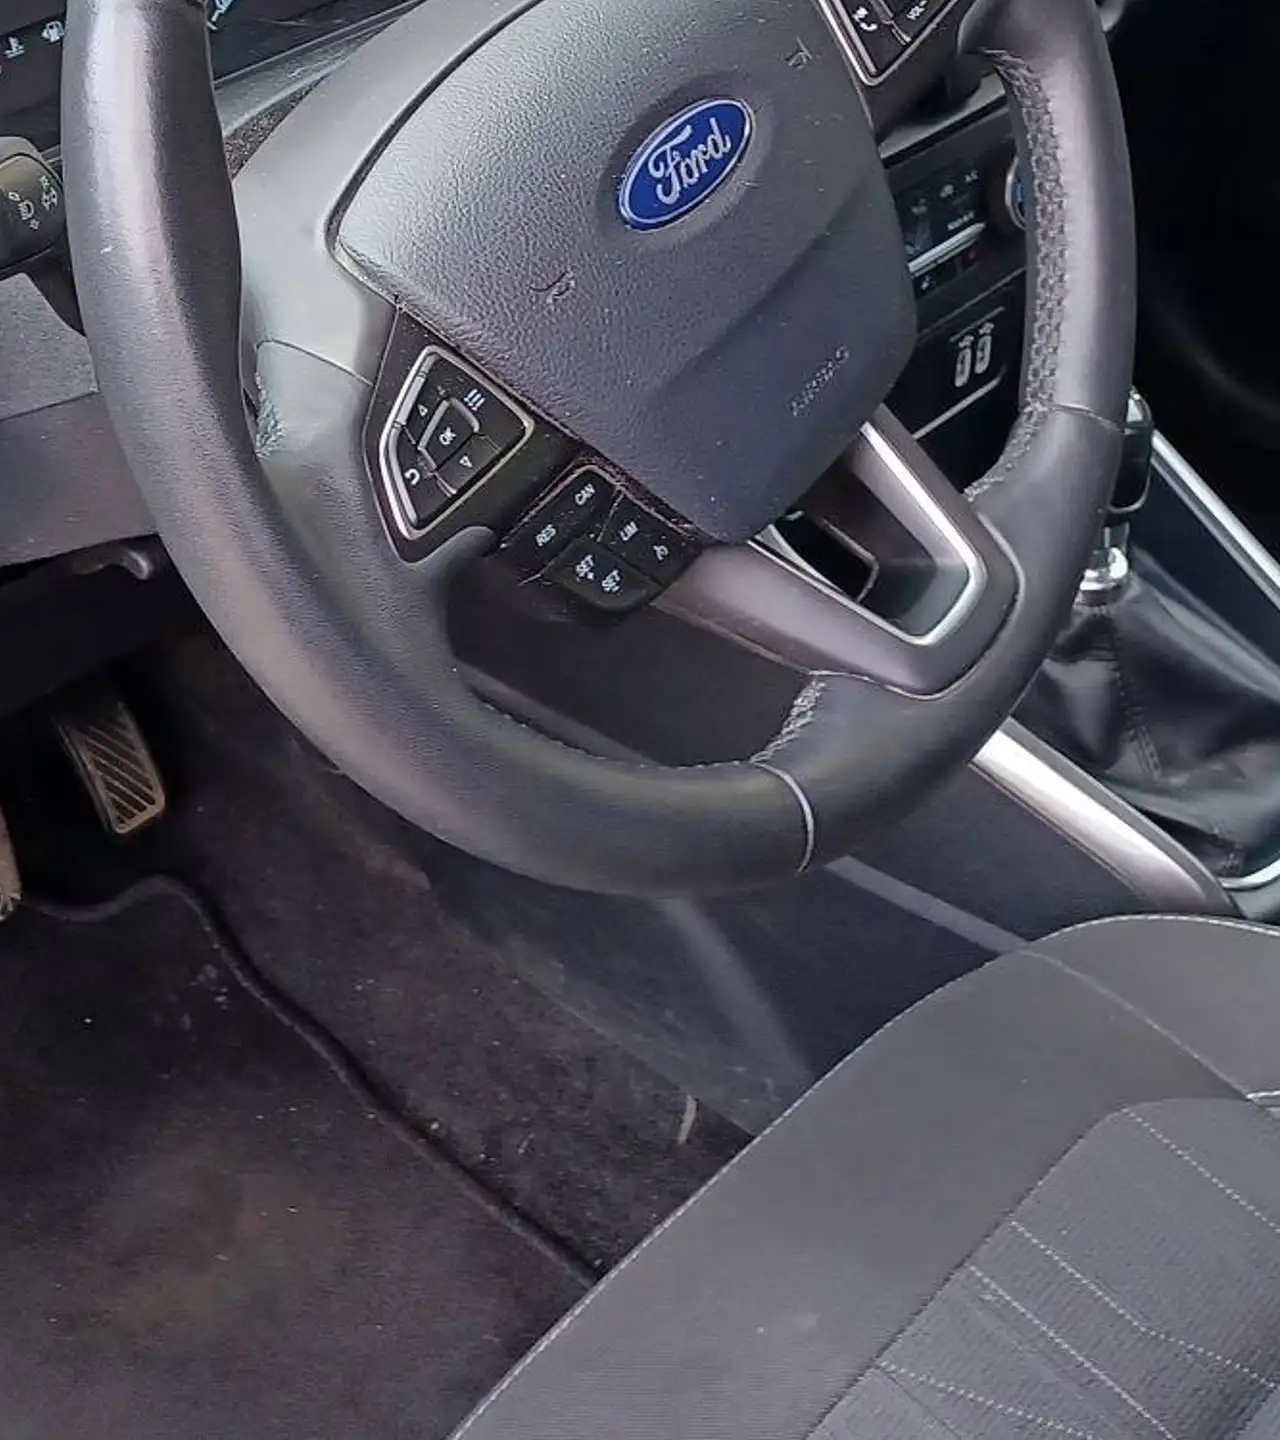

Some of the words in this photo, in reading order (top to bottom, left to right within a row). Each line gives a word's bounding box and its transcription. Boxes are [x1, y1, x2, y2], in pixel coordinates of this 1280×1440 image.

[647, 116, 732, 205] Ford
[438, 426, 458, 446] OK
[574, 483, 596, 506] CAN
[535, 523, 557, 547] RES
